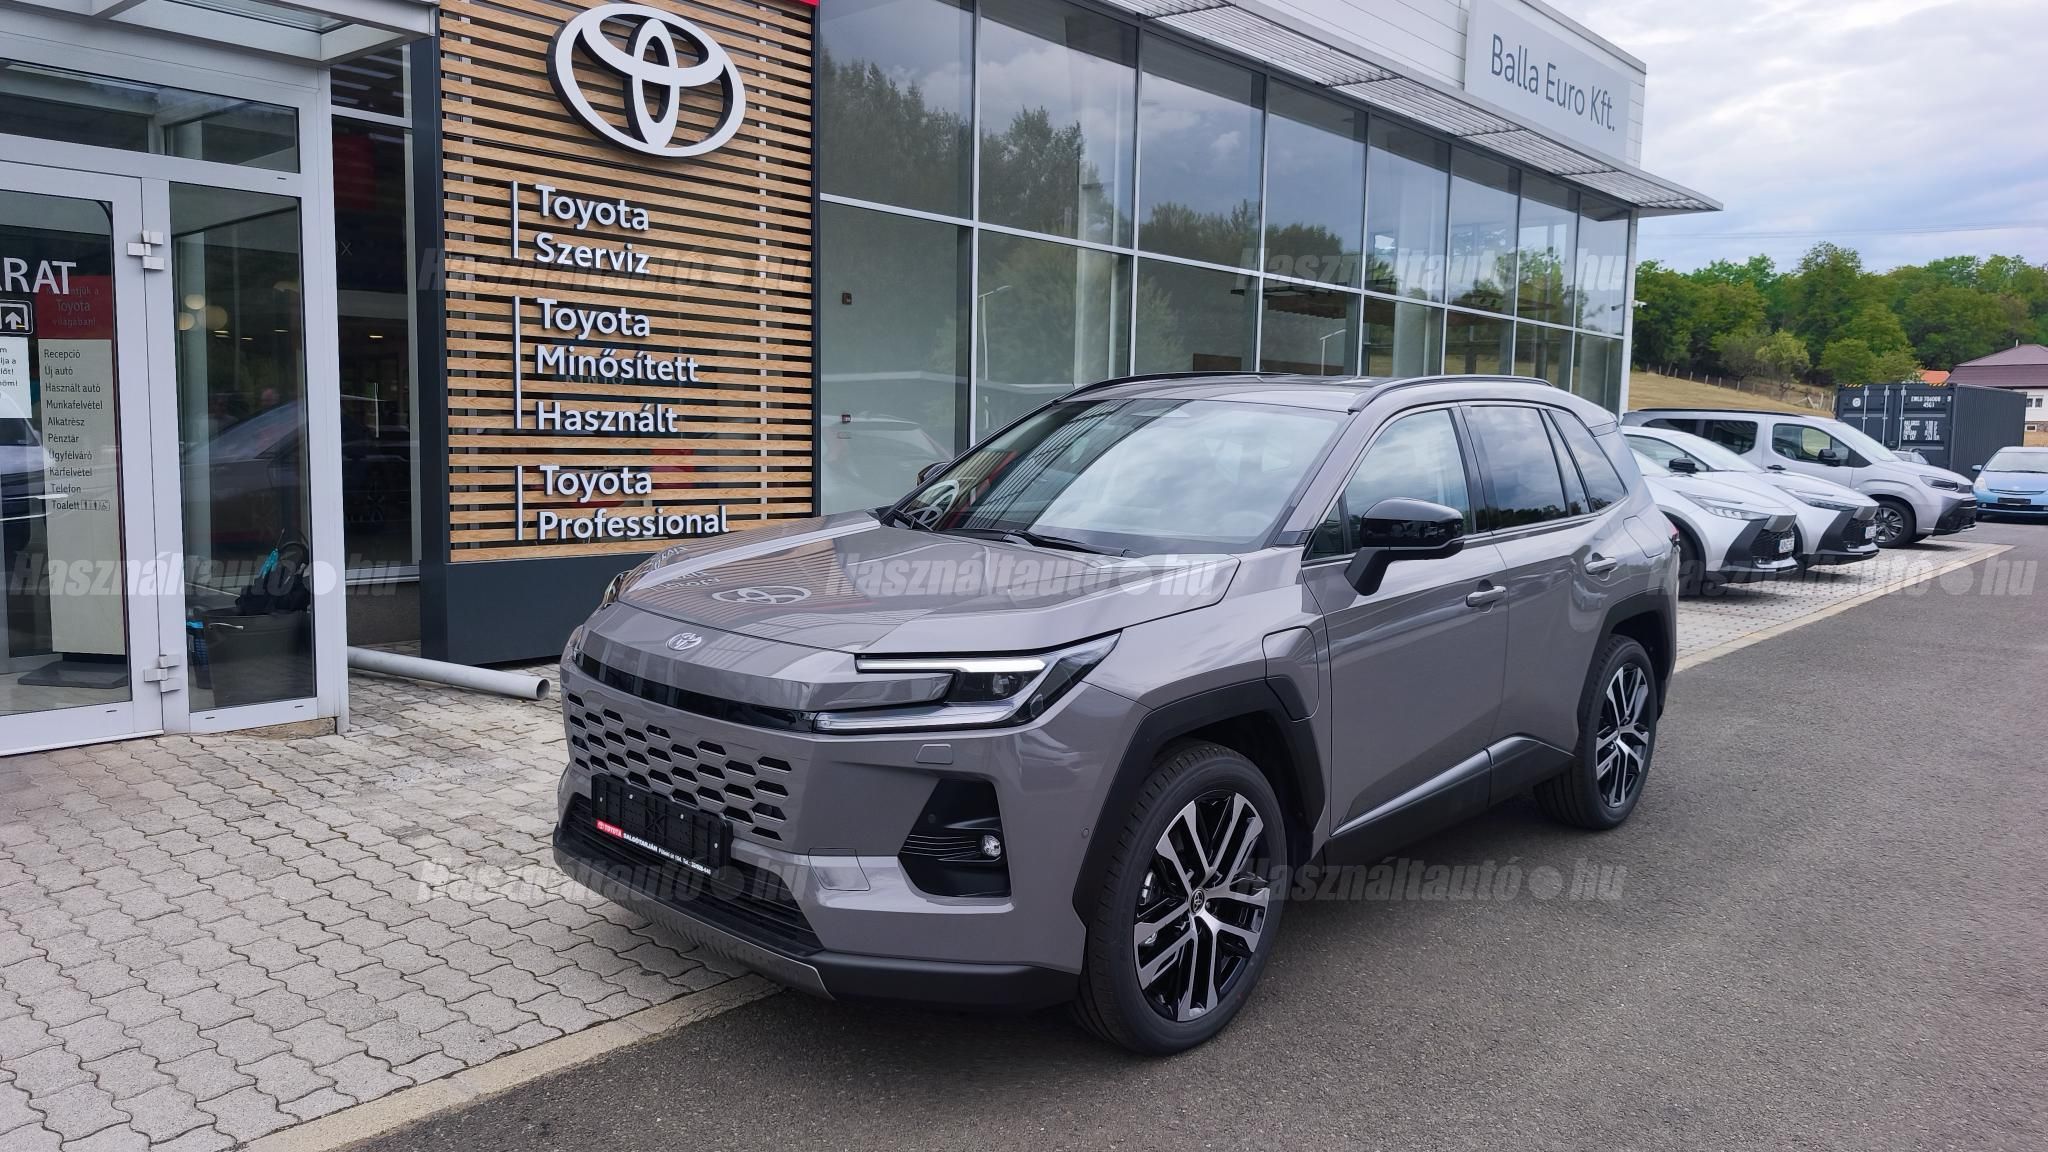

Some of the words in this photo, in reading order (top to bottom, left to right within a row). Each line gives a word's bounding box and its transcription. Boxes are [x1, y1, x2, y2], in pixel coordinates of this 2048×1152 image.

[1491, 34, 1539, 95] Balla
[1545, 62, 1585, 116] Euro
[1590, 85, 1616, 132] Kft.
[535, 184, 649, 231] Toyota
[534, 232, 650, 274] Szerviz
[0, 257, 77, 295] RAT
[57, 300, 91, 314] Toyota
[536, 297, 650, 341] Toyota
[44, 349, 81, 360] Recepció
[535, 344, 699, 381] Minősített
[44, 364, 53, 378] Új
[55, 367, 74, 375] autó
[45, 383, 81, 393] Használt
[82, 384, 101, 393] autó
[46, 400, 103, 410] Munkafelvétel
[47, 417, 85, 427] Alkatrész
[536, 401, 678, 432] Használt
[48, 433, 79, 443] Pénztár
[49, 466, 93, 477] Kárfelvétel
[51, 483, 81, 493] Telefon
[537, 465, 652, 503] Toyota
[52, 500, 80, 510] Toalett
[537, 505, 730, 541] Professional
[604, 825, 623, 838] TOYOTA
